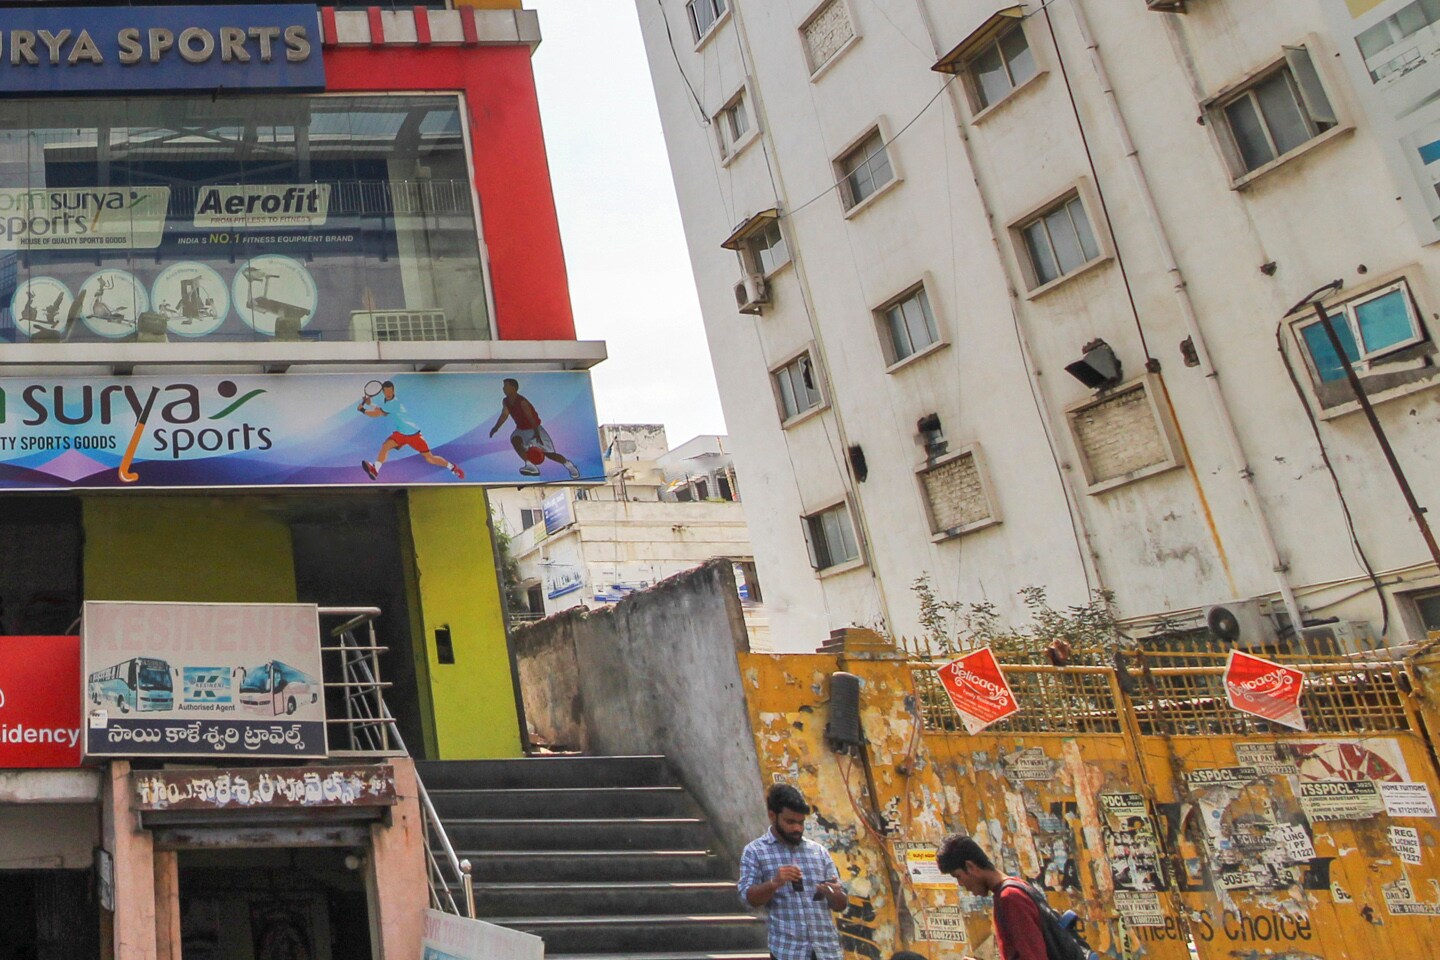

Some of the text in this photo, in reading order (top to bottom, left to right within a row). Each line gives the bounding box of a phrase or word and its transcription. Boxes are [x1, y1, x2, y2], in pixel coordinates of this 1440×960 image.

[118, 25, 311, 64] SPORTS
[197, 187, 320, 215] Aerofit
[52, 237, 78, 245] QUALITY
[21, 436, 70, 450] SPORTS
[74, 435, 116, 449] GOODS
[23, 383, 200, 482] surya
[153, 423, 272, 459] sports
[951, 663, 1009, 695] Delicacy
[178, 703, 235, 713] Authorised Agent
[108, 724, 160, 744] సాయి
[1300, 783, 1353, 795] TSSPDCL
[1394, 829, 1416, 838] REG.
[1223, 908, 1312, 941] Choice
